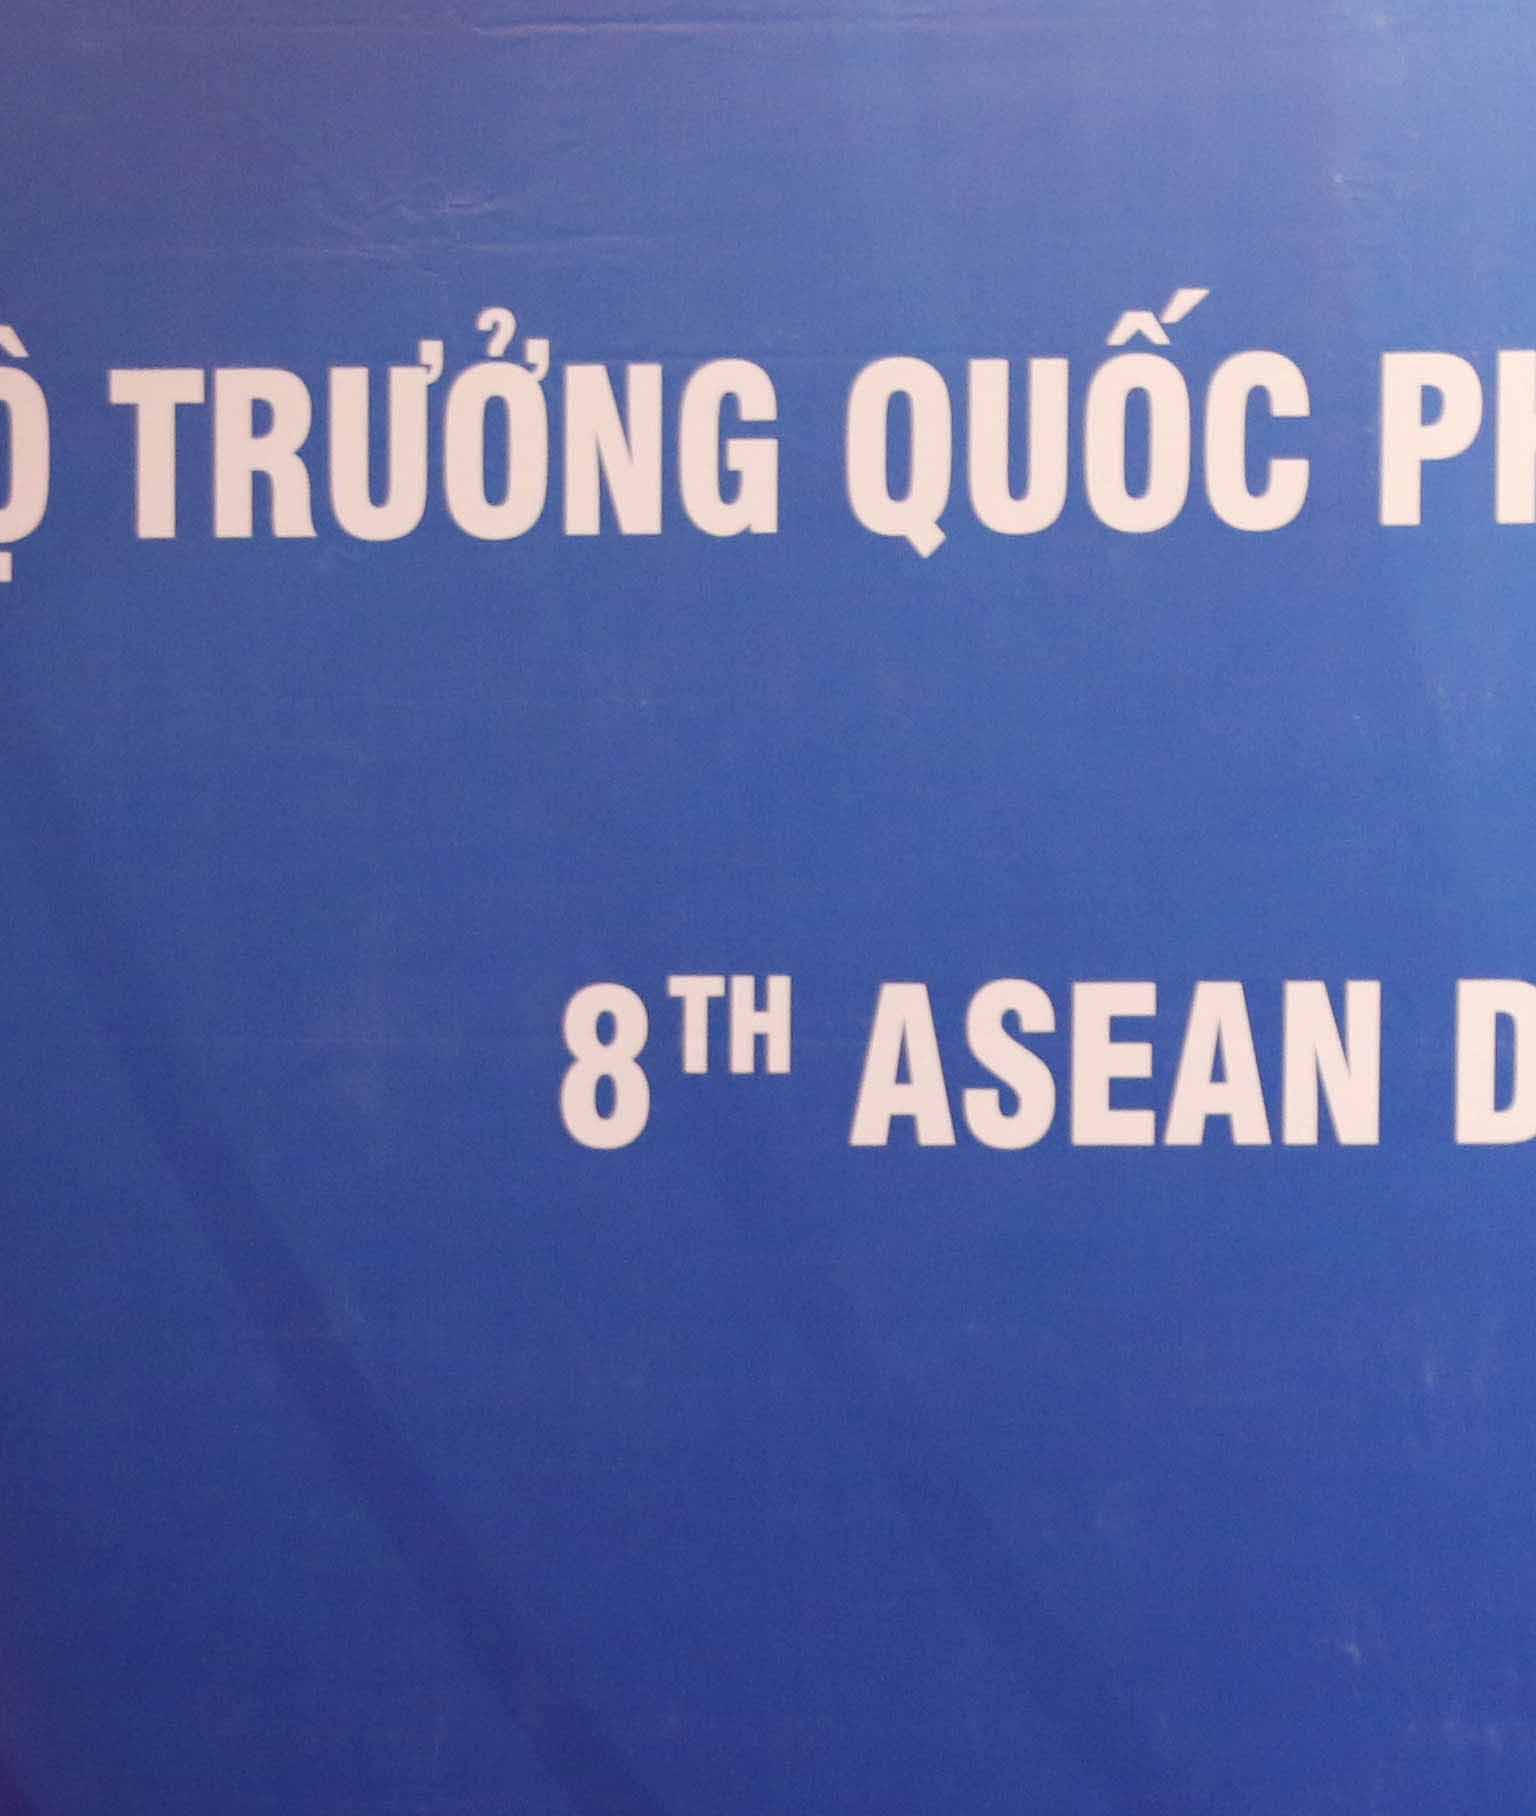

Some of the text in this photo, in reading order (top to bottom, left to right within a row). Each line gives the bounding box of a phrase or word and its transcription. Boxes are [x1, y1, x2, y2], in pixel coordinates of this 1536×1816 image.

[109, 307, 780, 542] TRƯỞNG
[845, 287, 1312, 558] QUỐC
[560, 973, 792, 1151] 8TH
[849, 978, 1383, 1151] ASEAN
